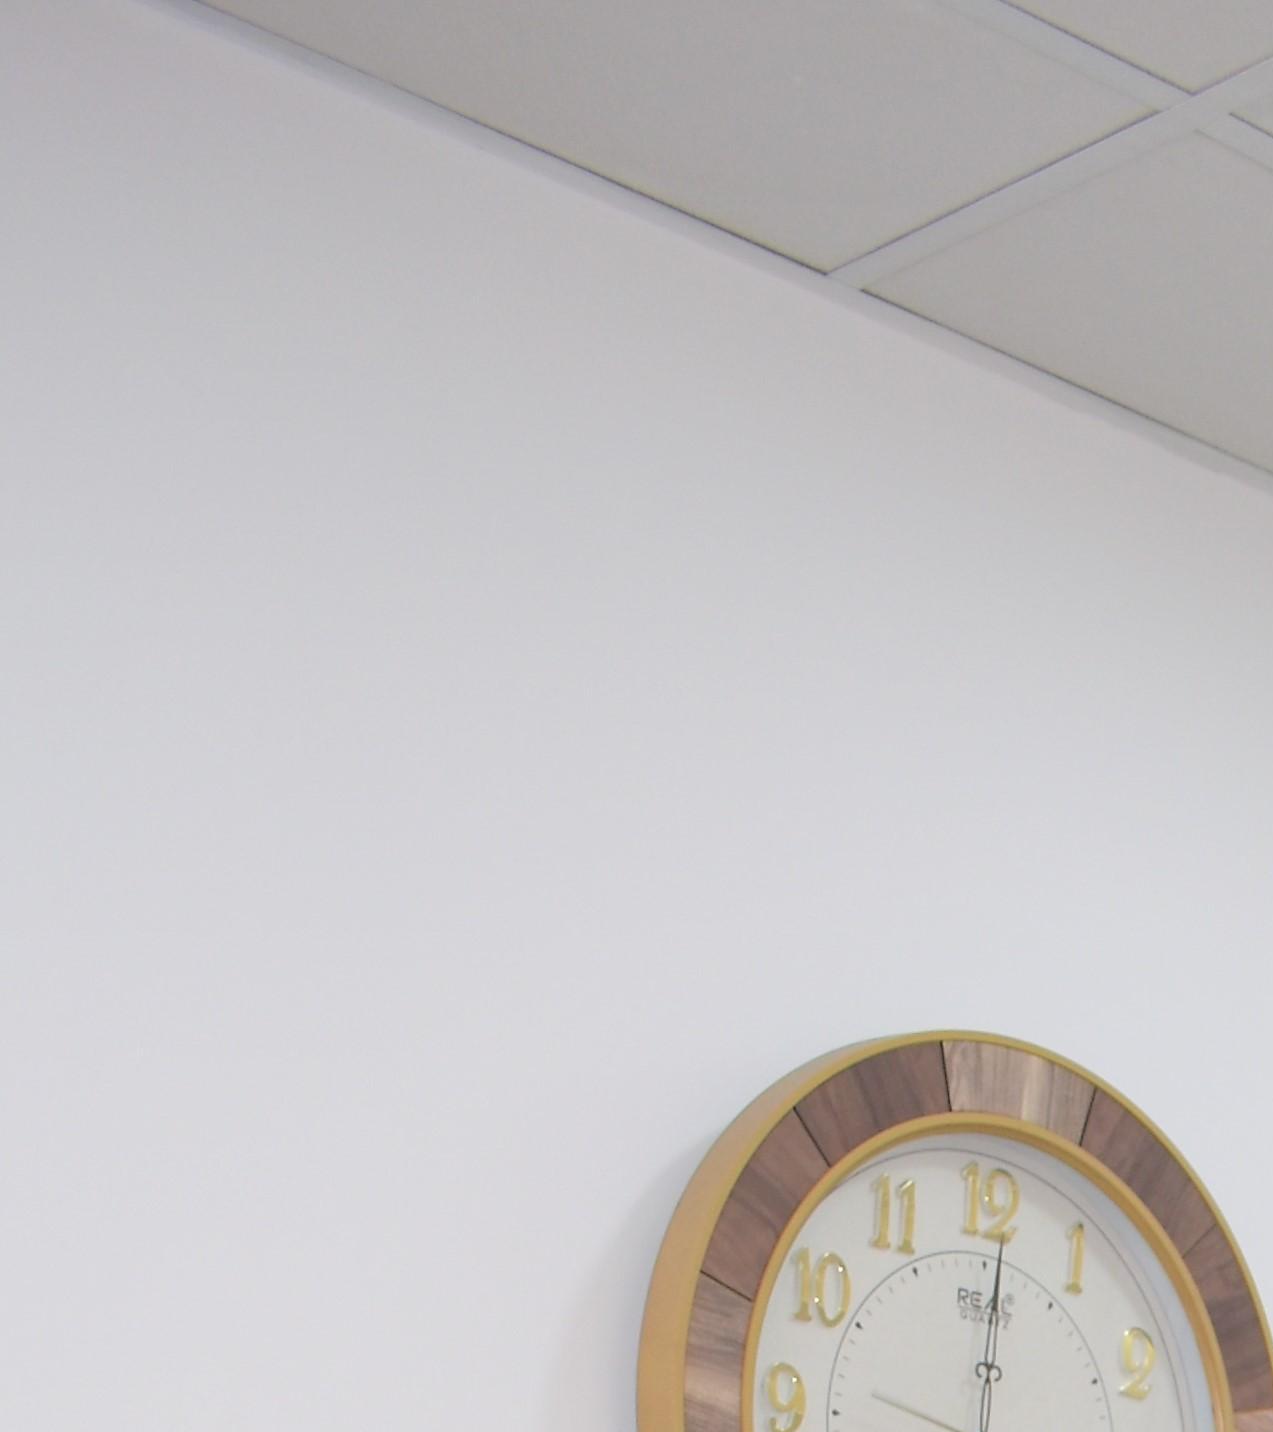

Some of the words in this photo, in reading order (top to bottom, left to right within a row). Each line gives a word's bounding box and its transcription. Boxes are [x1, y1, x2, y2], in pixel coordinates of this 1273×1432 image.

[871, 1173, 917, 1254] 11
[961, 1161, 1021, 1243] 12
[792, 1247, 851, 1328] 10
[1065, 1222, 1086, 1296] 1
[1119, 1327, 1156, 1399] 2
